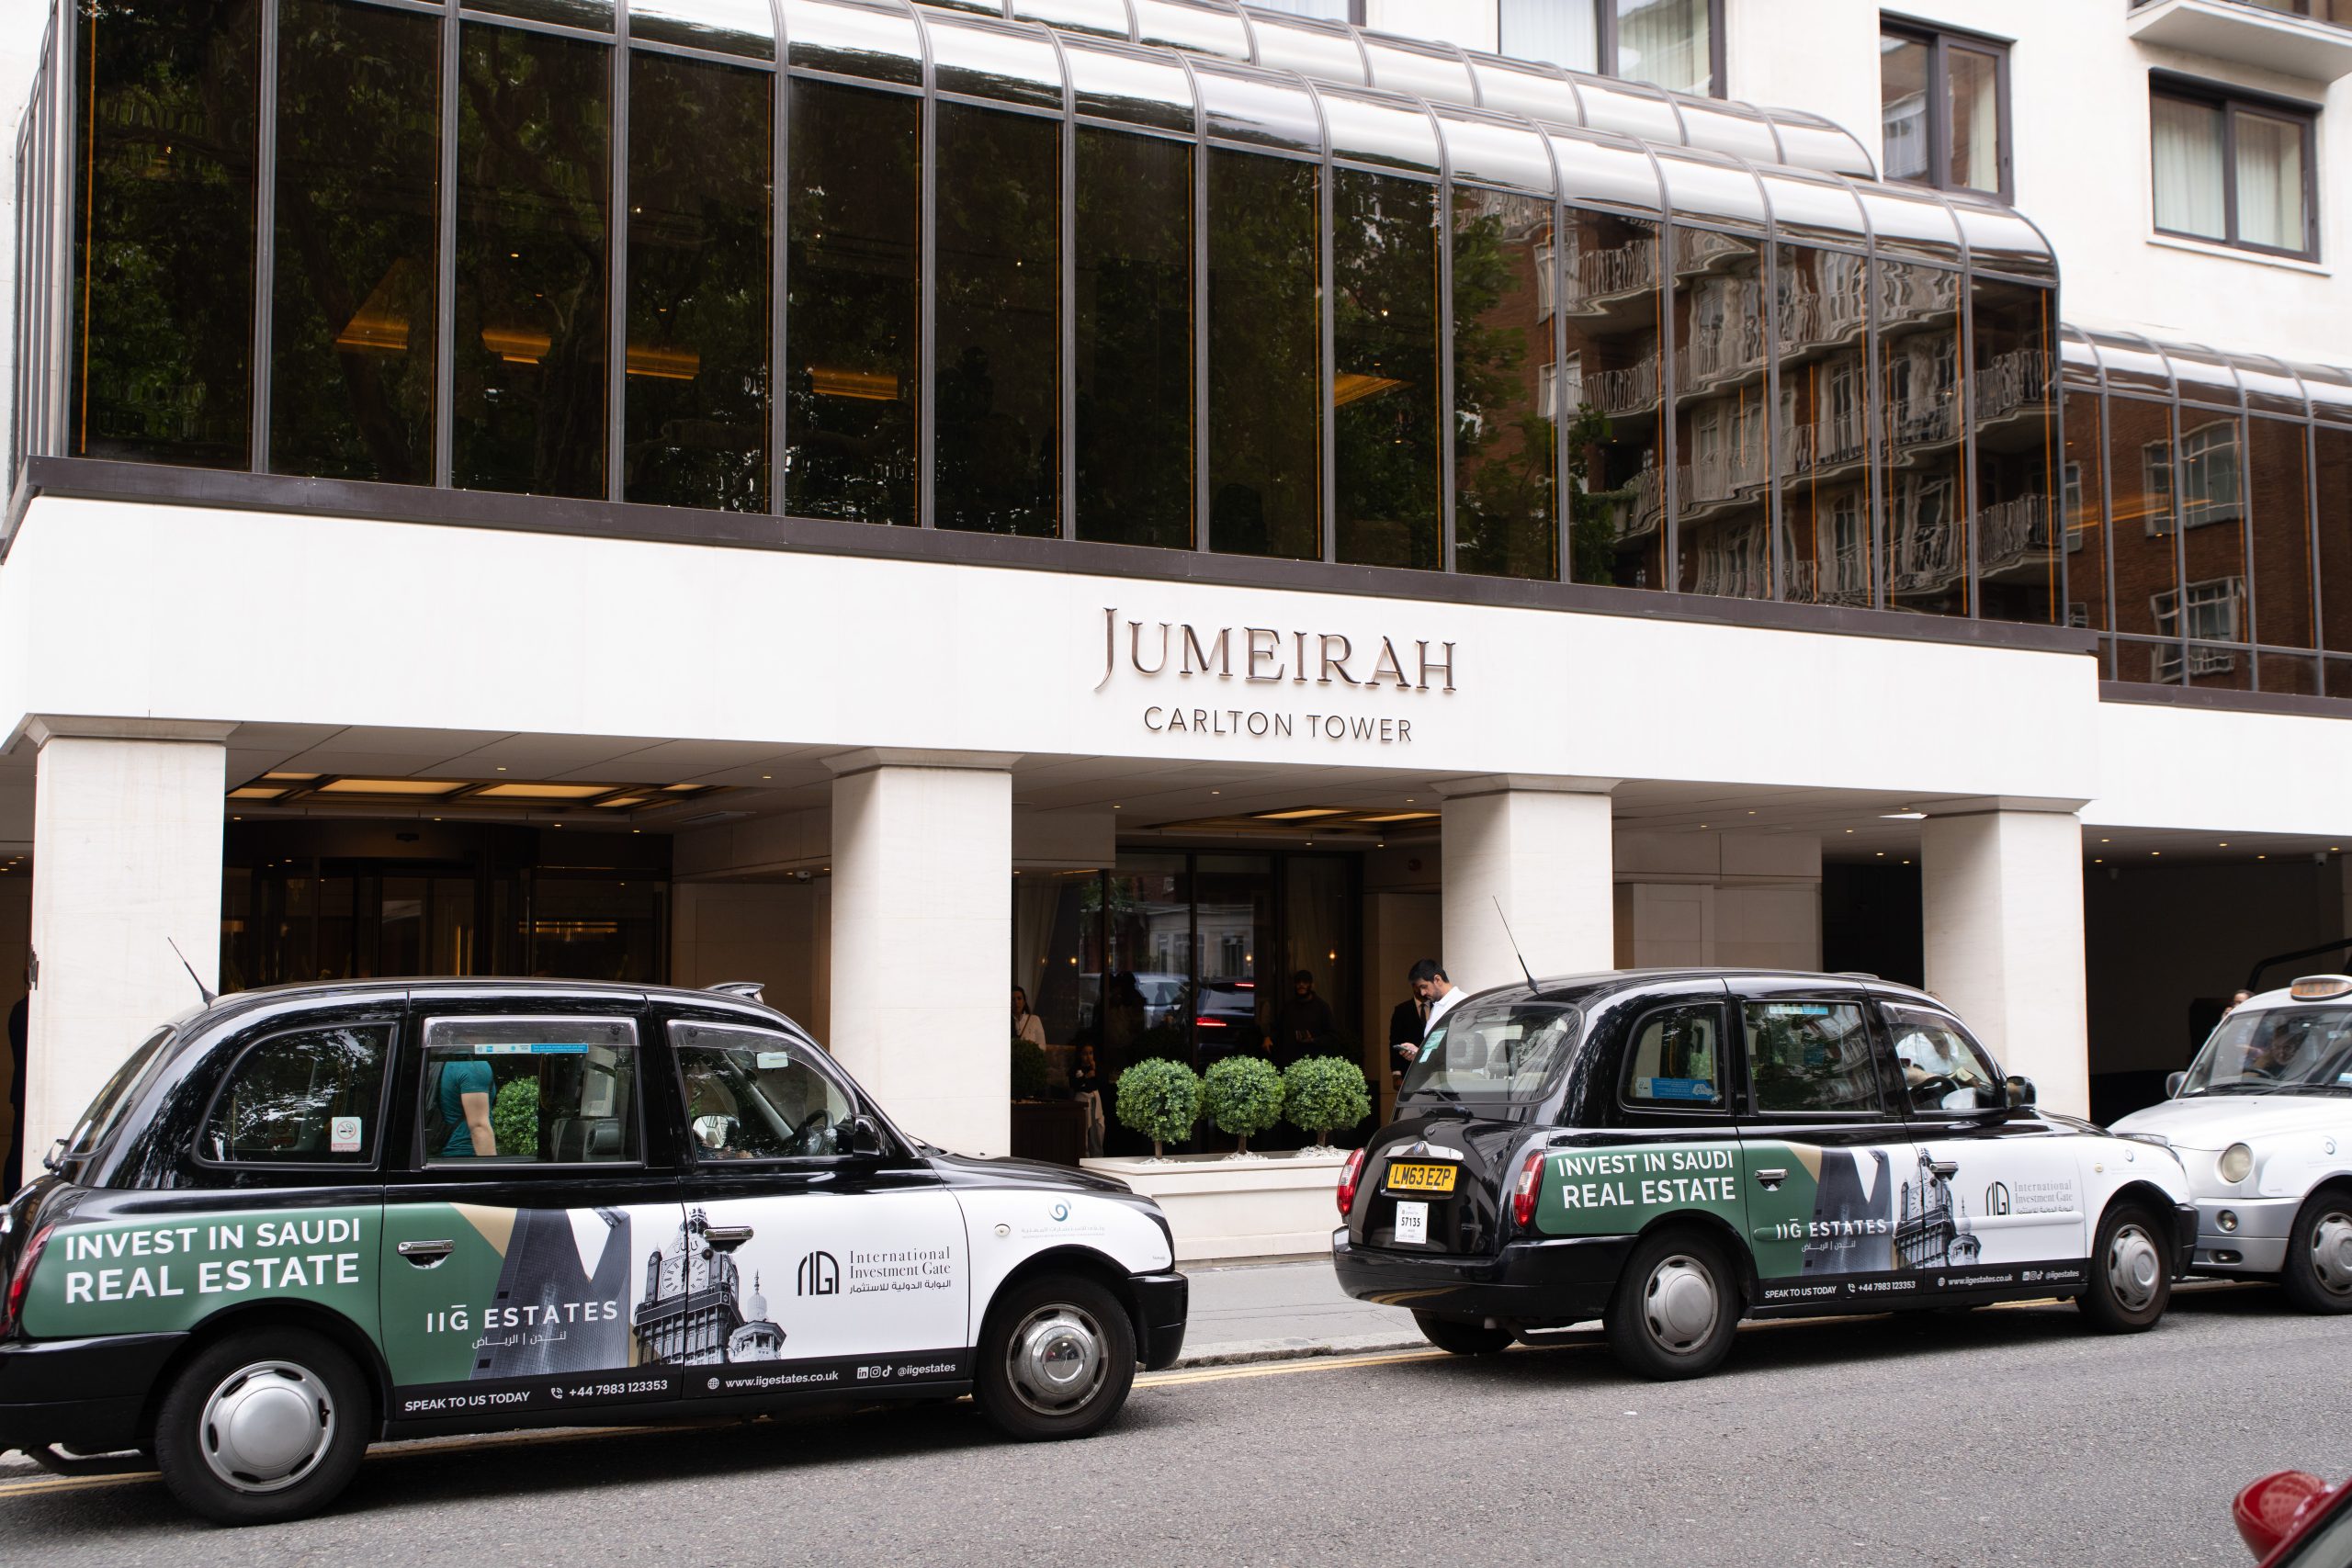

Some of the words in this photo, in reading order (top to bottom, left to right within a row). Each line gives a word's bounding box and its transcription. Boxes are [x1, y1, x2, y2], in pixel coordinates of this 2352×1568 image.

[1095, 607, 1457, 691] JUMEIRAH
[1144, 705, 1293, 737] CARLTON
[1306, 714, 1412, 742] TOWER
[1557, 1154, 1637, 1177] INVEST
[1644, 1153, 1666, 1171] IN
[1672, 1150, 1734, 1170] SAUDI
[1393, 1167, 1425, 1186] LM63
[1426, 1168, 1452, 1187] EZP
[2014, 1179, 2072, 1192] International
[1562, 1182, 1634, 1209] REAL
[1641, 1177, 1736, 1205] ESTATE
[2015, 1193, 2054, 1203] Investment
[2056, 1191, 2073, 1201] Gate
[1401, 1217, 1420, 1227] 57135
[1809, 1219, 1887, 1237] ESTATES
[65, 1227, 198, 1261] INVEST
[209, 1224, 243, 1250] IN
[255, 1218, 360, 1247] SAUDI
[850, 1247, 950, 1264] International
[65, 1265, 184, 1304] REAL
[198, 1252, 359, 1293] ESTATE
[850, 1267, 919, 1279] Investment
[922, 1261, 951, 1275] Gate
[1948, 1274, 2013, 1286] www.iigestates.co.uk
[2045, 1270, 2080, 1280] @iigestates
[849, 1282, 889, 1295] للاستثمار
[891, 1280, 922, 1292] الدولية
[924, 1280, 952, 1290] البوابة
[1765, 1288, 1789, 1298] SPEAK
[1790, 1288, 1801, 1296] TO
[1802, 1287, 1813, 1295] US
[1814, 1286, 1837, 1294] TODAY
[1858, 1283, 1872, 1292] +44
[1873, 1281, 1891, 1291] 7983
[1892, 1280, 1916, 1290] 123353
[484, 1300, 618, 1329] ESTATES
[725, 1371, 839, 1389] www.iigestates.co.uk
[897, 1363, 956, 1377] @iigestates
[404, 1400, 446, 1412] SPEAK
[448, 1397, 467, 1408] TO
[469, 1395, 486, 1406] US
[490, 1391, 531, 1405] TODAY
[569, 1384, 594, 1397] +44
[596, 1382, 626, 1395] 7983
[628, 1380, 668, 1393] 123353
